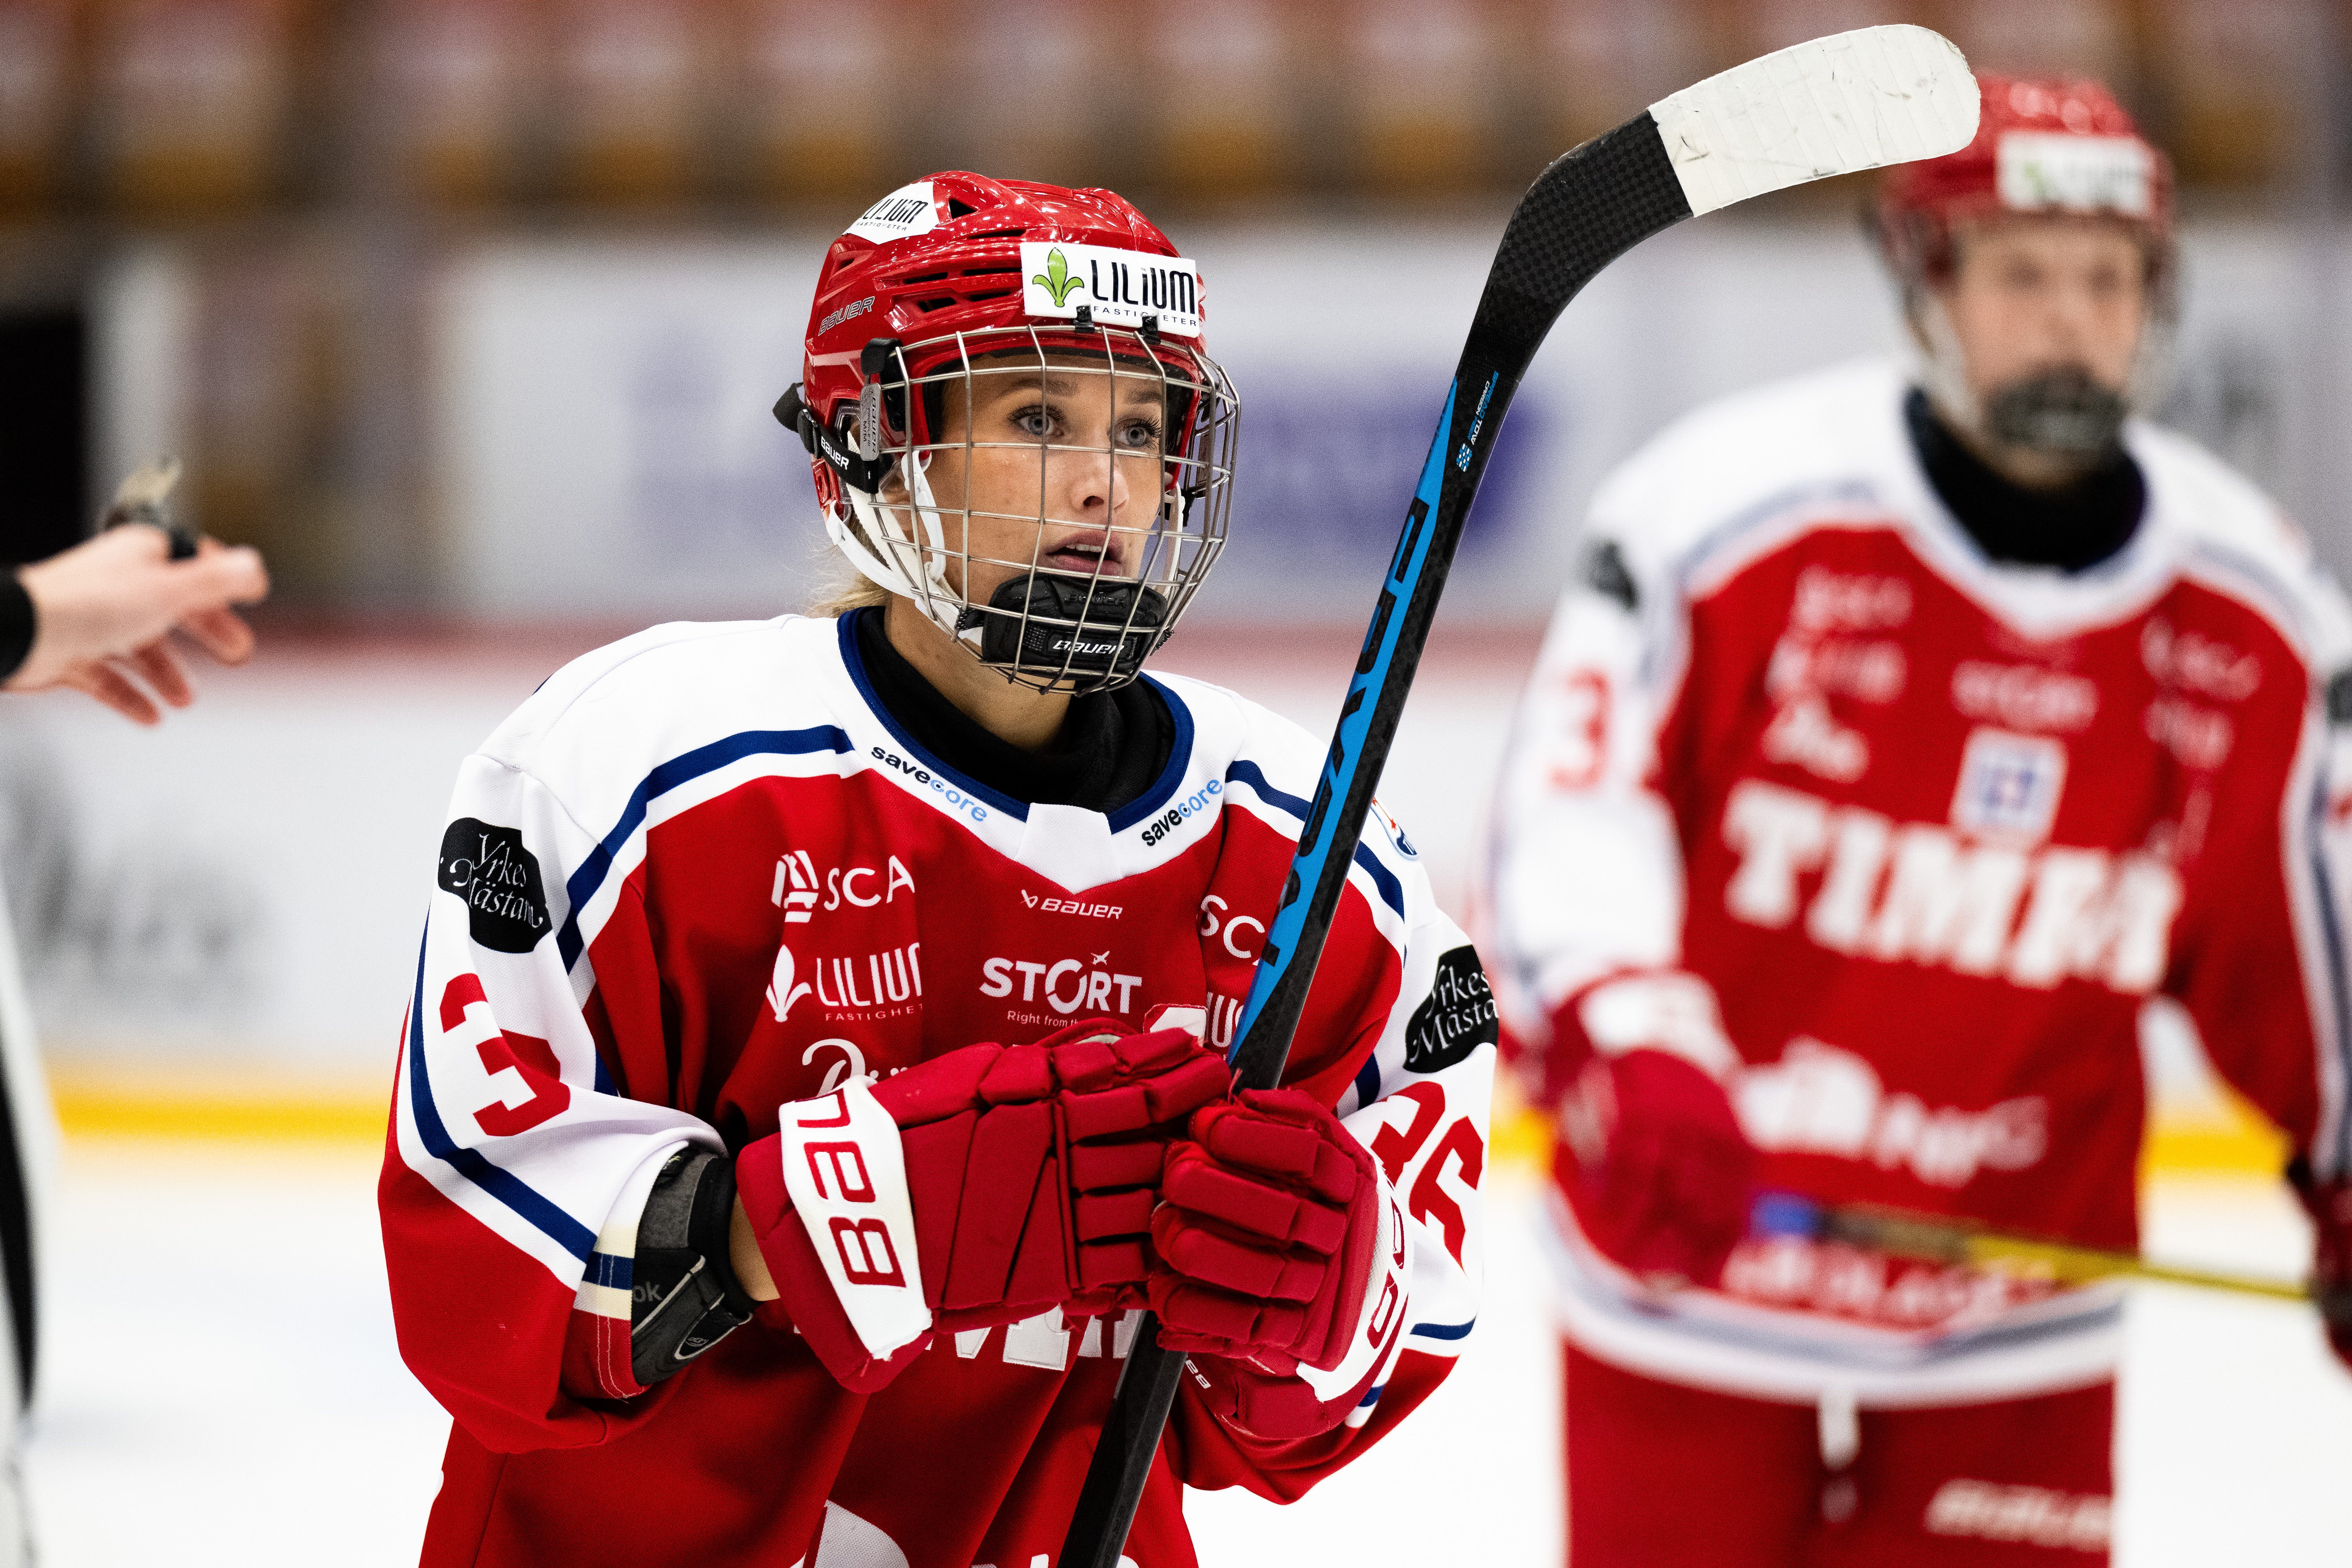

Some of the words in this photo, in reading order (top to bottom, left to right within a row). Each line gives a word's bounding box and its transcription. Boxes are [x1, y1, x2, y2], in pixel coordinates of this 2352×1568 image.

[862, 198, 929, 224] LILIUM
[1091, 260, 1195, 314] LILIUM
[818, 296, 875, 336] BAUER
[1094, 306, 1196, 326] FASTIETER
[1476, 380, 1490, 416] CARBON
[1471, 420, 1483, 445] TOW
[821, 436, 849, 470] BAUER
[871, 746, 987, 822] savecore
[1142, 778, 1223, 846] savecore
[824, 855, 915, 911] SCA
[1040, 898, 1123, 919] BAUER
[1201, 895, 1265, 966] SC
[1007, 1010, 1040, 1024] Right
[1045, 1015, 1068, 1027] from
